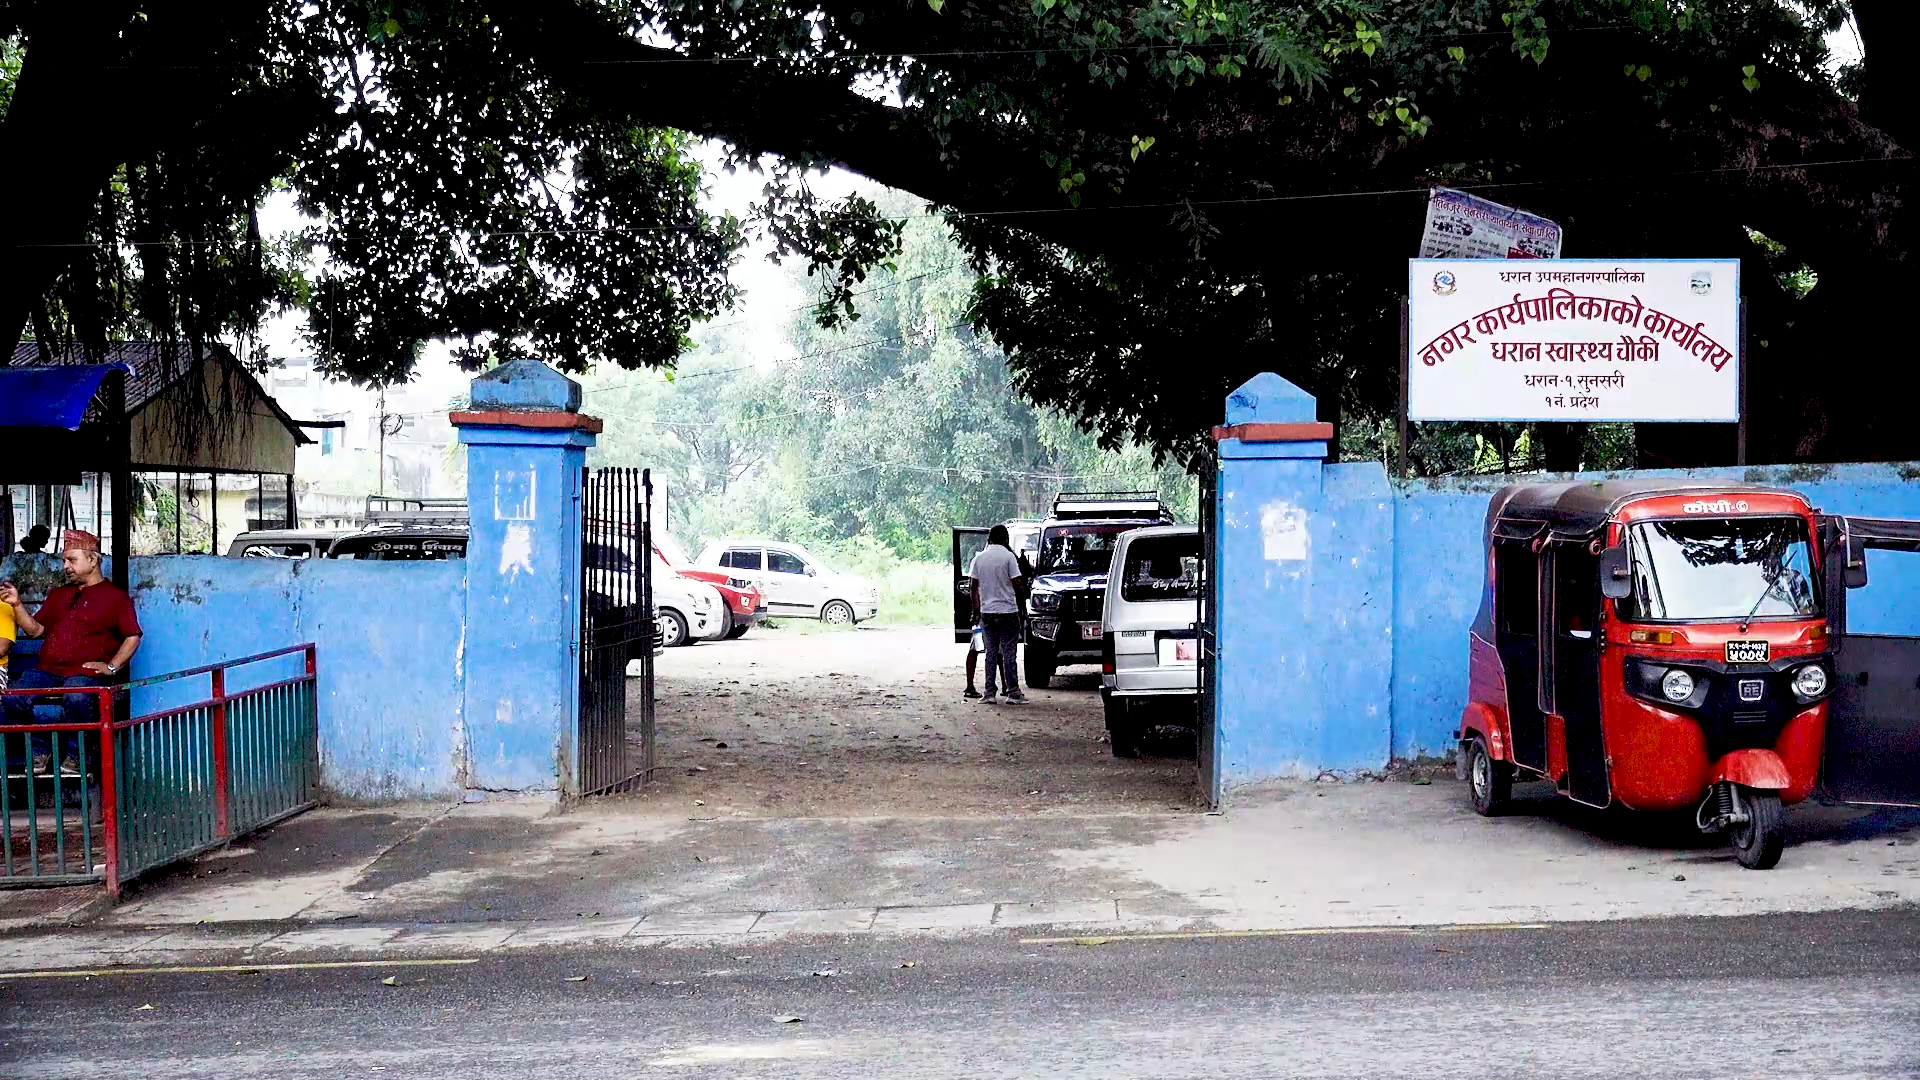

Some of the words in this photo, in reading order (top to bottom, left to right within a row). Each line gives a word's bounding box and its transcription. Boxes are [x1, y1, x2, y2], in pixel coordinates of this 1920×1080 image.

[1500, 271, 1531, 284] धरान
[1535, 268, 1646, 285] उपमहानगरपालिका
[1417, 320, 1477, 367] नगर
[1472, 287, 1645, 335] कार्यपालिकाको
[1643, 308, 1733, 372] कार्यालय
[1490, 342, 1541, 362] धरान
[1545, 342, 1612, 362] स्वास्थ्य
[1616, 335, 1659, 362] चौकी
[1570, 391, 1599, 410] प्रदेश
